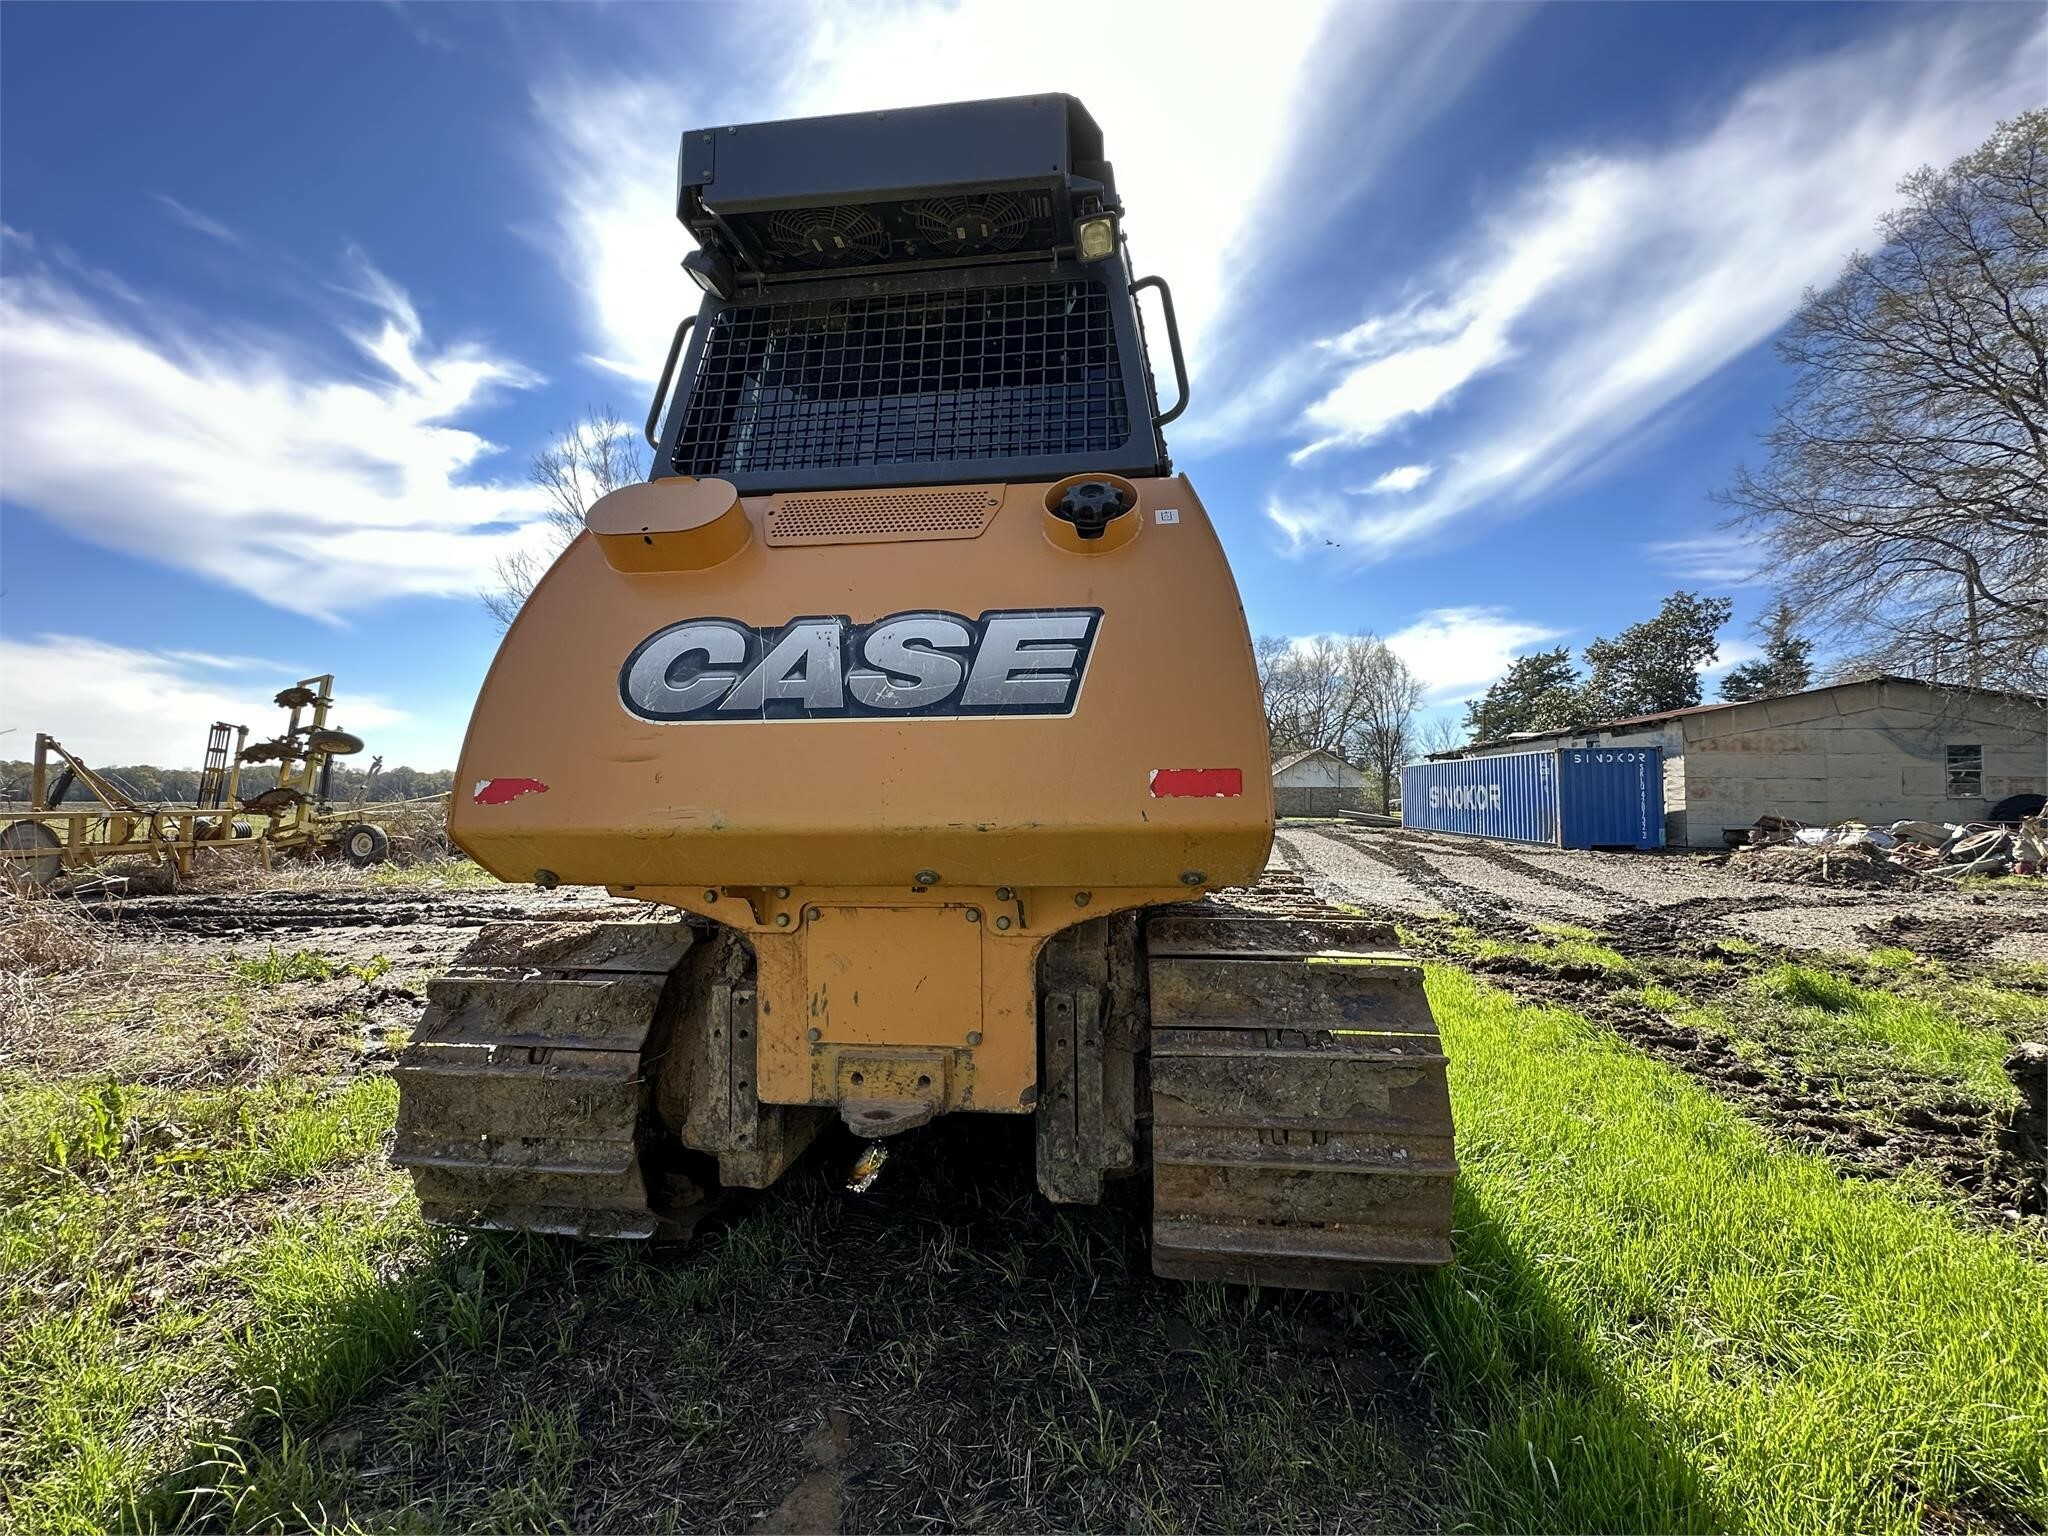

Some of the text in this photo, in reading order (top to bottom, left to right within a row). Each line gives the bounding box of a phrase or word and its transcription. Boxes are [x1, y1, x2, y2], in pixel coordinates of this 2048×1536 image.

[627, 615, 1093, 713] CASE
[1574, 753, 1646, 763] SINOKOR
[1429, 784, 1501, 811] SINOKOR
